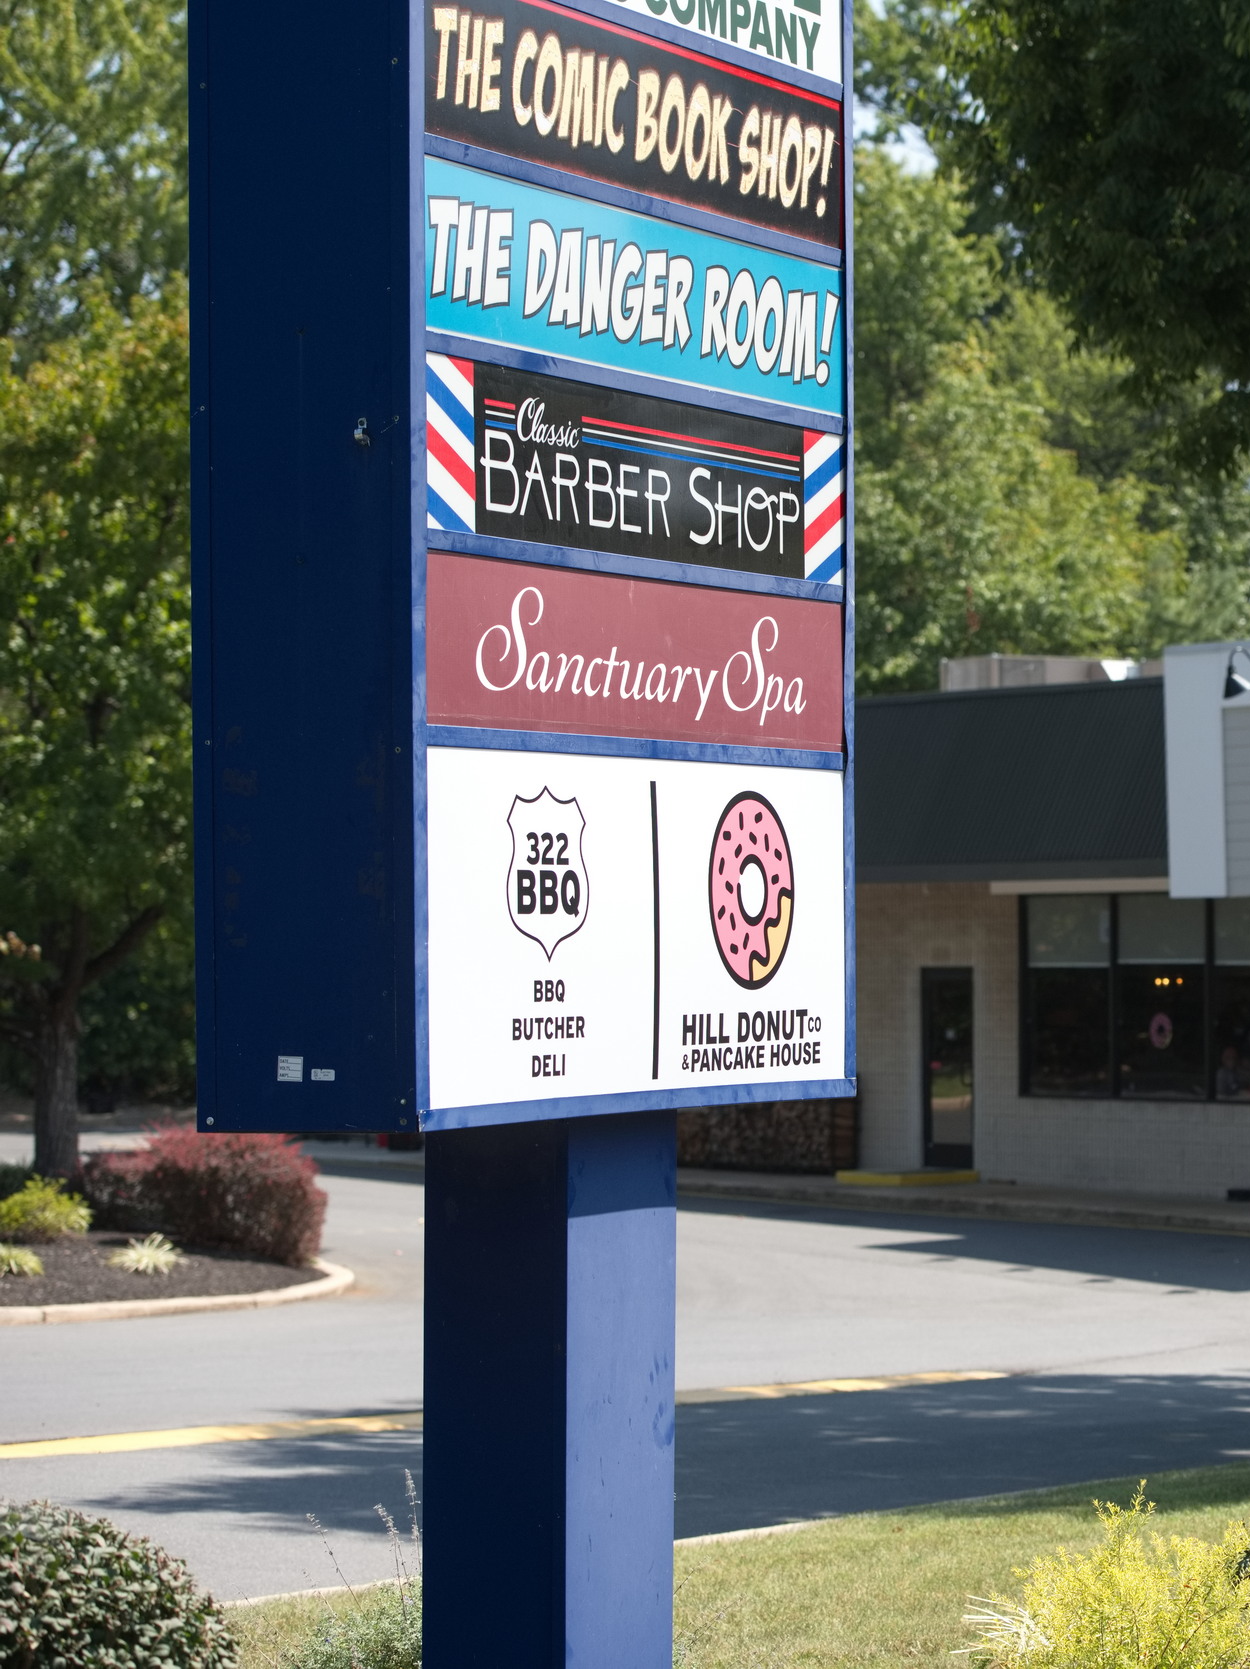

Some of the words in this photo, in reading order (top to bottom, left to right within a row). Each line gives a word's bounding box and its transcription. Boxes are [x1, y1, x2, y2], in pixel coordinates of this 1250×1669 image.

[434, 8, 503, 113] THE
[512, 29, 629, 154] COMIC
[635, 69, 733, 185] BOOK
[739, 106, 835, 217] SHOP!
[428, 195, 514, 310] THE
[523, 219, 693, 354] DANGER
[700, 264, 839, 387] ROOM!
[516, 397, 581, 449] Classic
[480, 429, 671, 537] BARBER
[689, 467, 800, 554] SHOP
[475, 587, 719, 721] Sanctuary
[722, 616, 807, 726] Spa
[526, 832, 570, 865] 322
[516, 869, 581, 918] BBQ
[533, 979, 566, 1003] BBQ
[512, 1016, 585, 1041] BUTCHER
[682, 1012, 730, 1046] HILL
[531, 1054, 566, 1078] DELI
[770, 1041, 821, 1067] HOUSE
